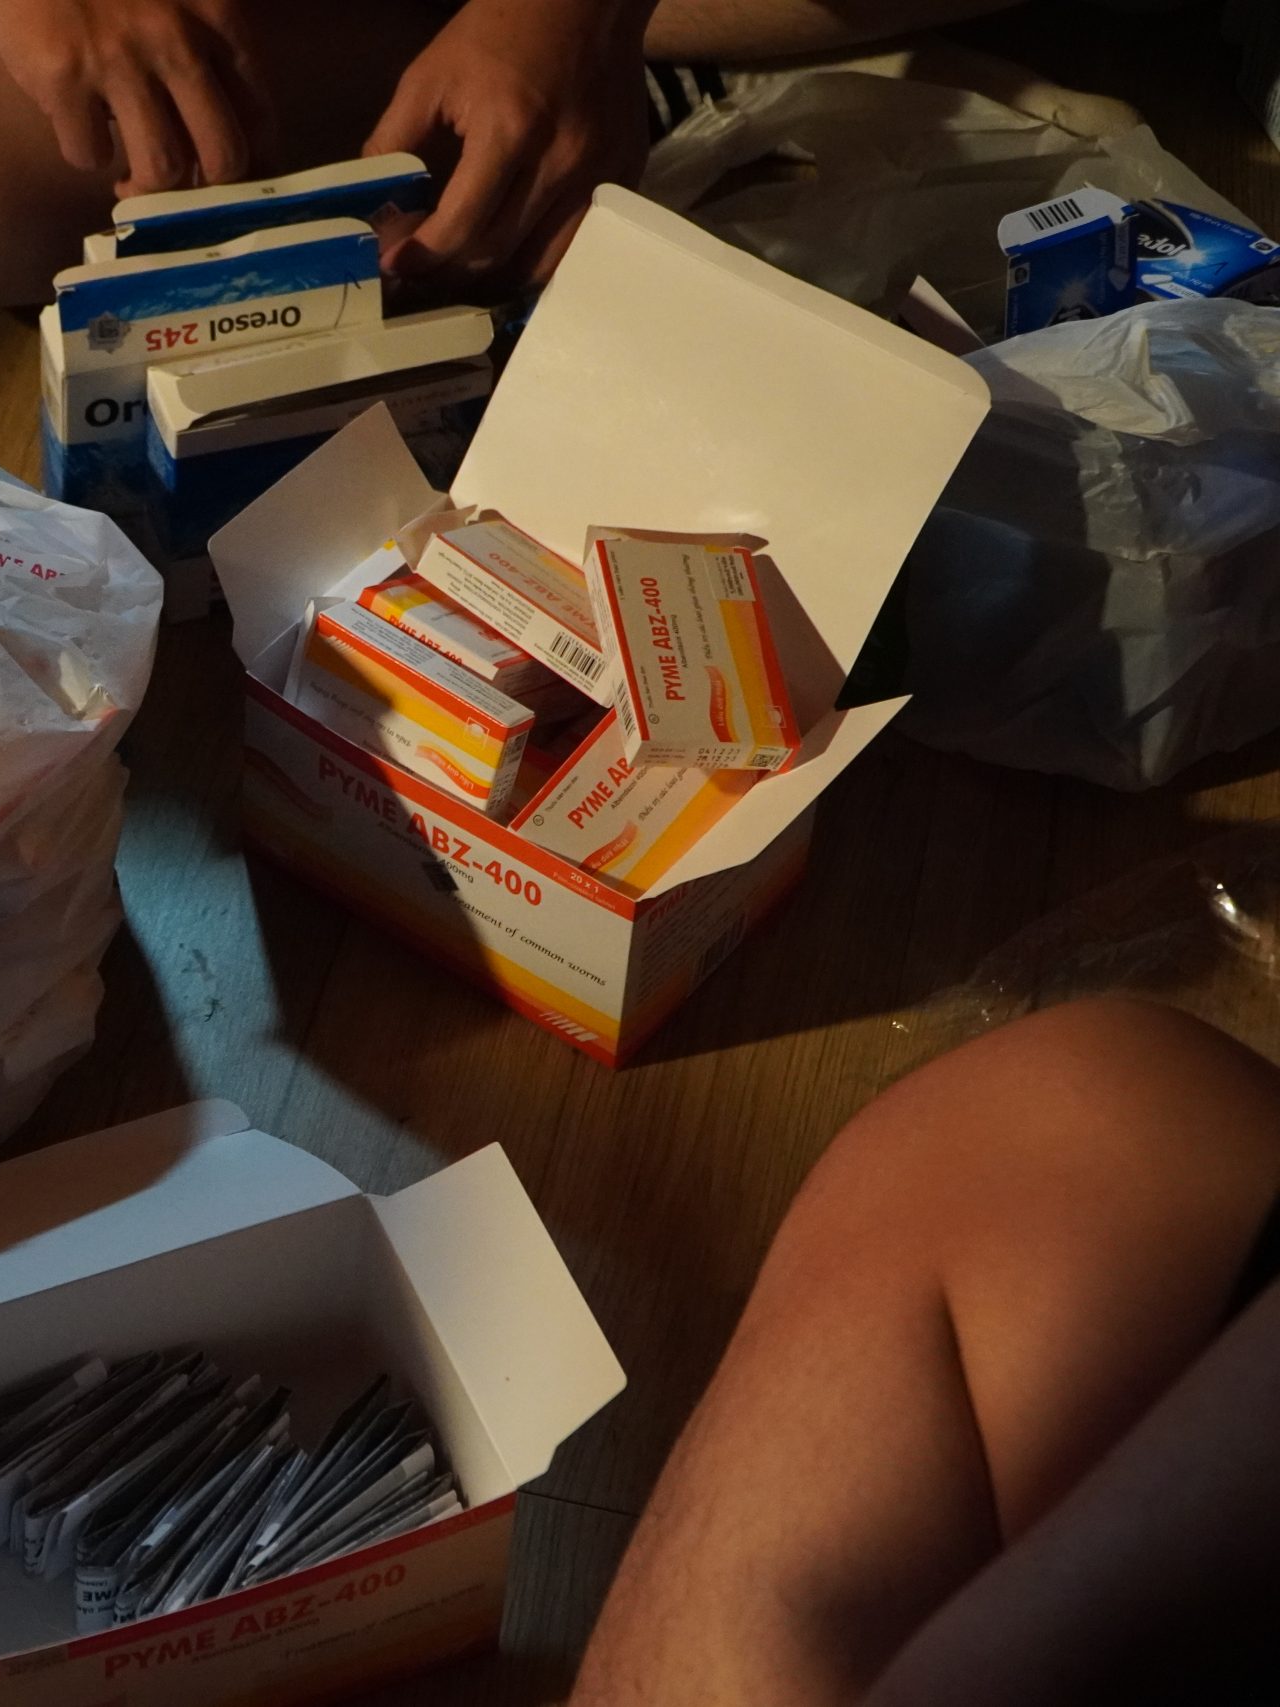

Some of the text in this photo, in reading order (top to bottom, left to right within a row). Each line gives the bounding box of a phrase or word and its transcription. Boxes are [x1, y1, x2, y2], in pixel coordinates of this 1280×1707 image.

[145, 306, 301, 352] Oresol 245
[640, 578, 685, 700] PYME ABZ-400
[319, 757, 542, 906] PYME ABZ-400
[568, 781, 614, 829] PYME
[437, 858, 477, 884] 400mg
[569, 871, 584, 883] 20
[583, 881, 591, 889] x
[504, 924, 517, 937] of
[517, 933, 567, 965] common
[565, 961, 608, 987] worms
[103, 1627, 217, 1679] PYME
[229, 1563, 407, 1642] ABZ-400
